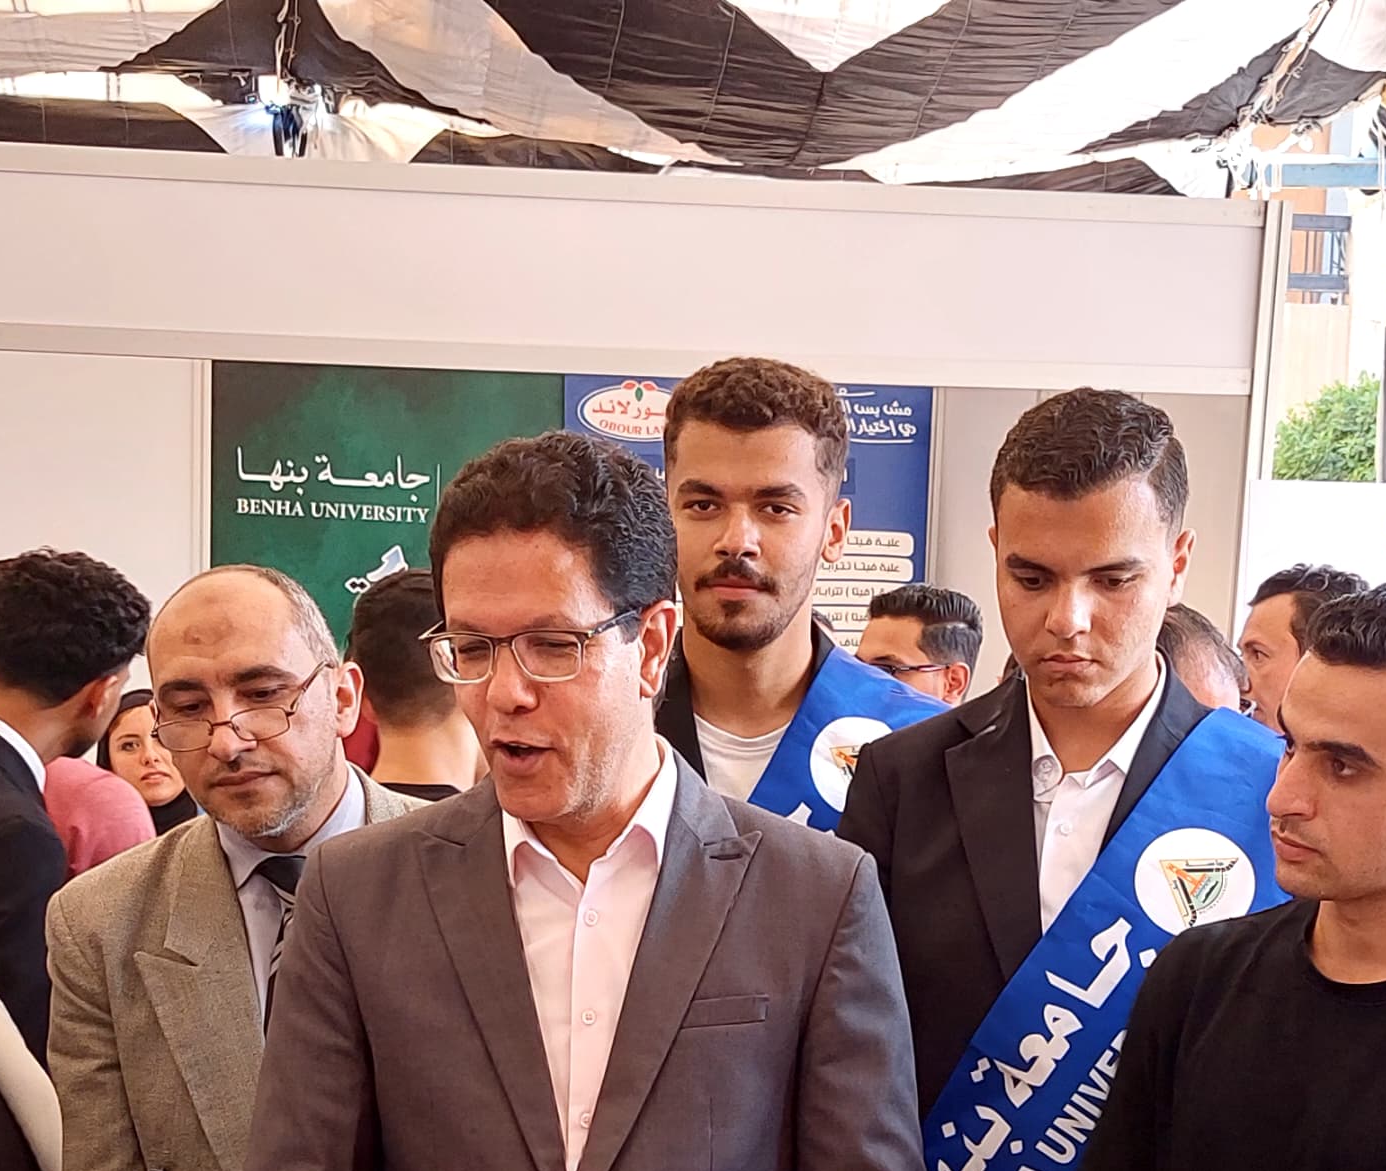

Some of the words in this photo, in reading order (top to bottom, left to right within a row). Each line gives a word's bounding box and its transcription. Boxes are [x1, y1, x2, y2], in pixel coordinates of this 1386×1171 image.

[599, 420, 641, 434] OBOUR
[647, 426, 663, 435] LA
[237, 446, 309, 496] بنها
[315, 454, 431, 502] جامعة
[237, 498, 305, 517] BENHA
[311, 502, 429, 523] UNIVERSITY
[972, 918, 1157, 1110] جامعة
[1041, 1029, 1125, 1165] UNIVE
